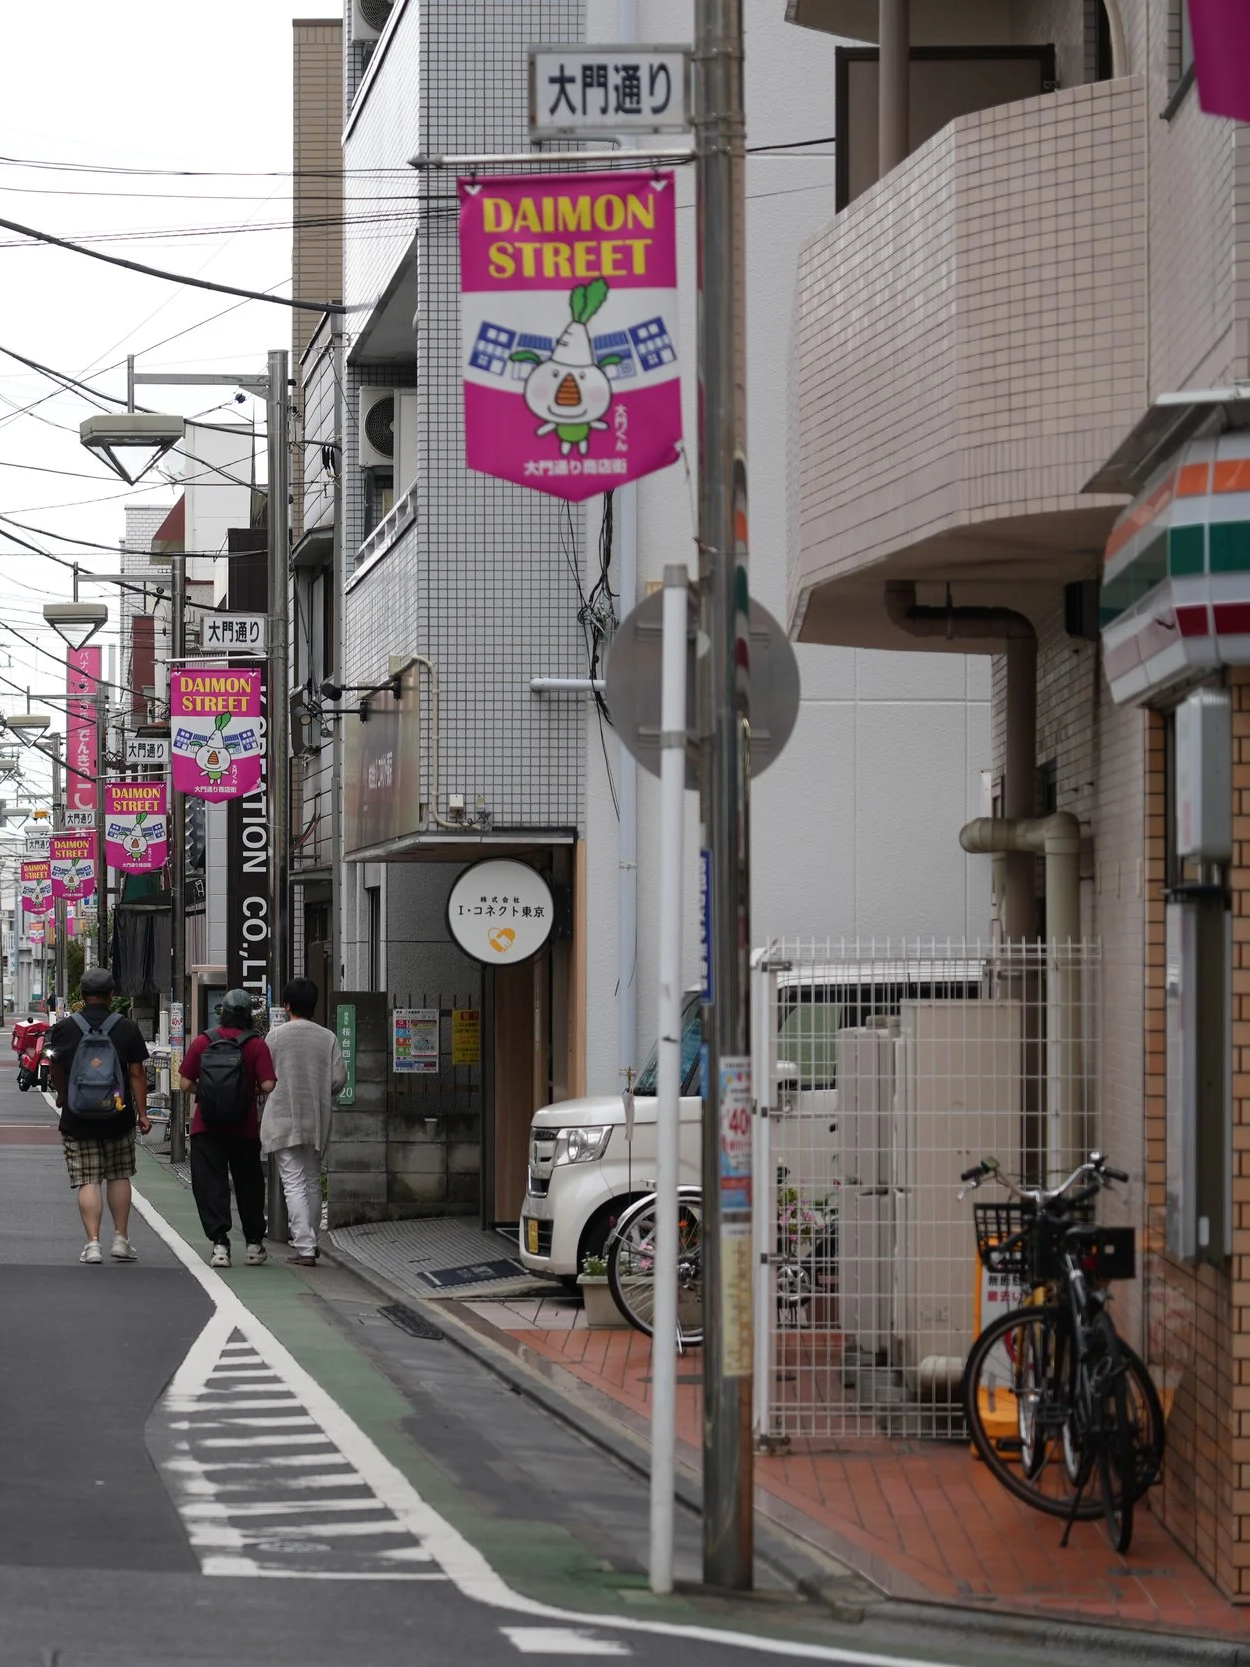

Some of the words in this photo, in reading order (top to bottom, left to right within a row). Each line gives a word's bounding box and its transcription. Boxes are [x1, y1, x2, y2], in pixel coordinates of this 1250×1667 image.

[548, 62, 671, 116] 大門通り
[482, 193, 655, 233] DAIMON
[488, 239, 653, 279] STREET
[614, 404, 628, 453] 大門くん
[524, 458, 628, 476] 大門通り商店街
[208, 620, 260, 643] 大門通り
[180, 677, 251, 693] DAIMON
[182, 696, 250, 712] STREET
[128, 742, 164, 759] 大門通り
[112, 787, 161, 799] DAIMON
[113, 800, 160, 812] STREET
[67, 813, 93, 824] 大門通り
[54, 840, 89, 849] DAIMON
[55, 849, 88, 858] STREET
[23, 863, 49, 872] DAIMON
[24, 872, 48, 880] STREET
[480, 896, 520, 904] 株式会社
[339, 1086, 353, 1098] 20
